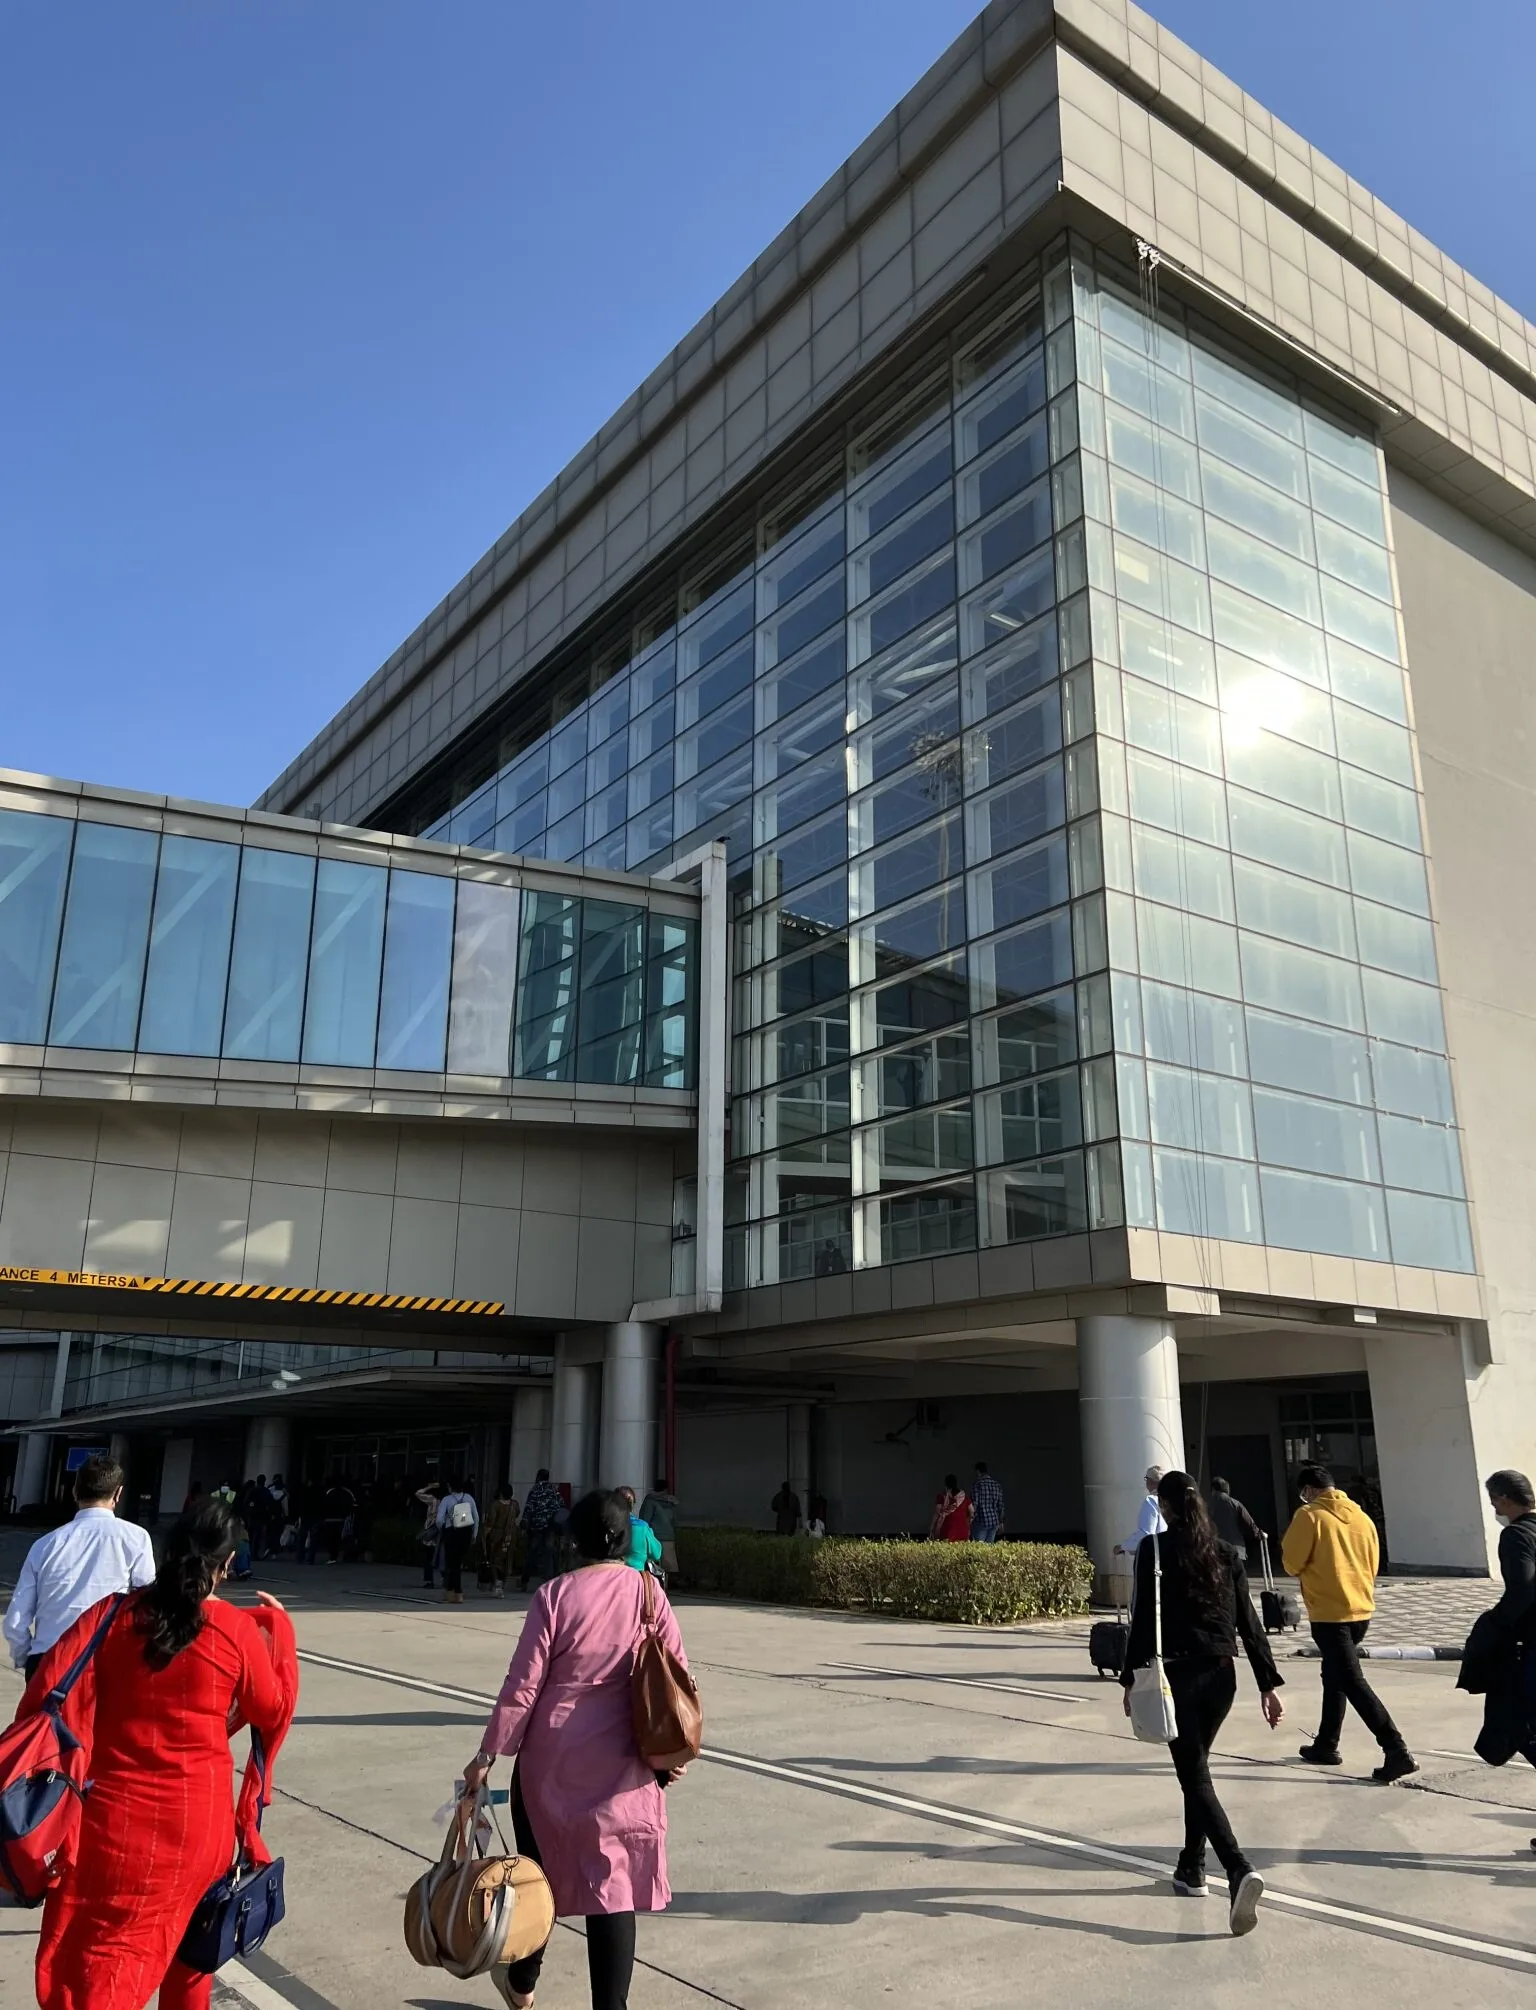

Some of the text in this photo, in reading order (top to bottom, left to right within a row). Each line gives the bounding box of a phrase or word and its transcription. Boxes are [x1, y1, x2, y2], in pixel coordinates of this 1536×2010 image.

[0, 1267, 127, 1287] ANCE 4 METERS
